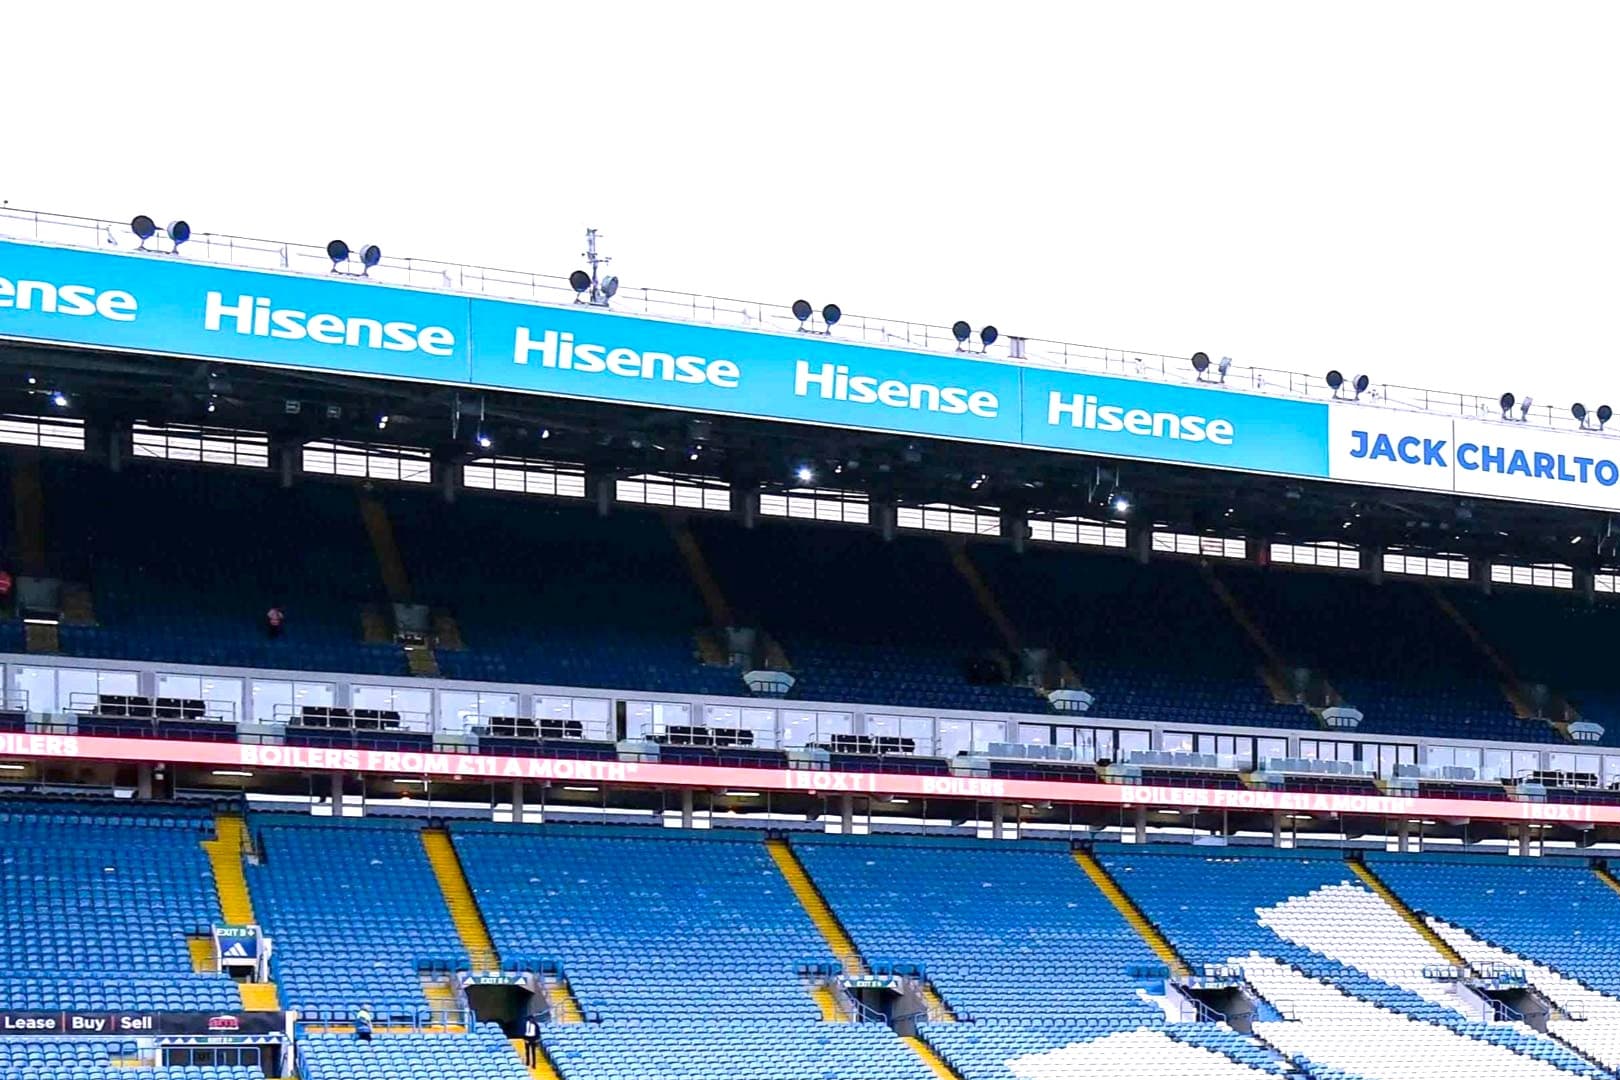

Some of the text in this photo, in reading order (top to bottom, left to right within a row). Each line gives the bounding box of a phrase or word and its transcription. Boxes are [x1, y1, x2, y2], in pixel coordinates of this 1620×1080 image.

[205, 291, 455, 356] Hisense
[512, 326, 740, 389] Hisense
[794, 359, 998, 419] Hisense
[1047, 391, 1235, 445] Hisense
[1349, 430, 1447, 467] JACK
[241, 745, 359, 768] BOILERS
[368, 751, 448, 773] FROM
[456, 757, 497, 775] £11
[499, 759, 521, 777] A
[799, 772, 865, 791] BOXT
[922, 776, 1004, 795] BOILERS
[1121, 785, 1207, 804] BOILERS
[1214, 789, 1273, 808] FROM
[217, 928, 238, 936] EXIT
[5, 1016, 152, 1031] Lease Buy Sell
